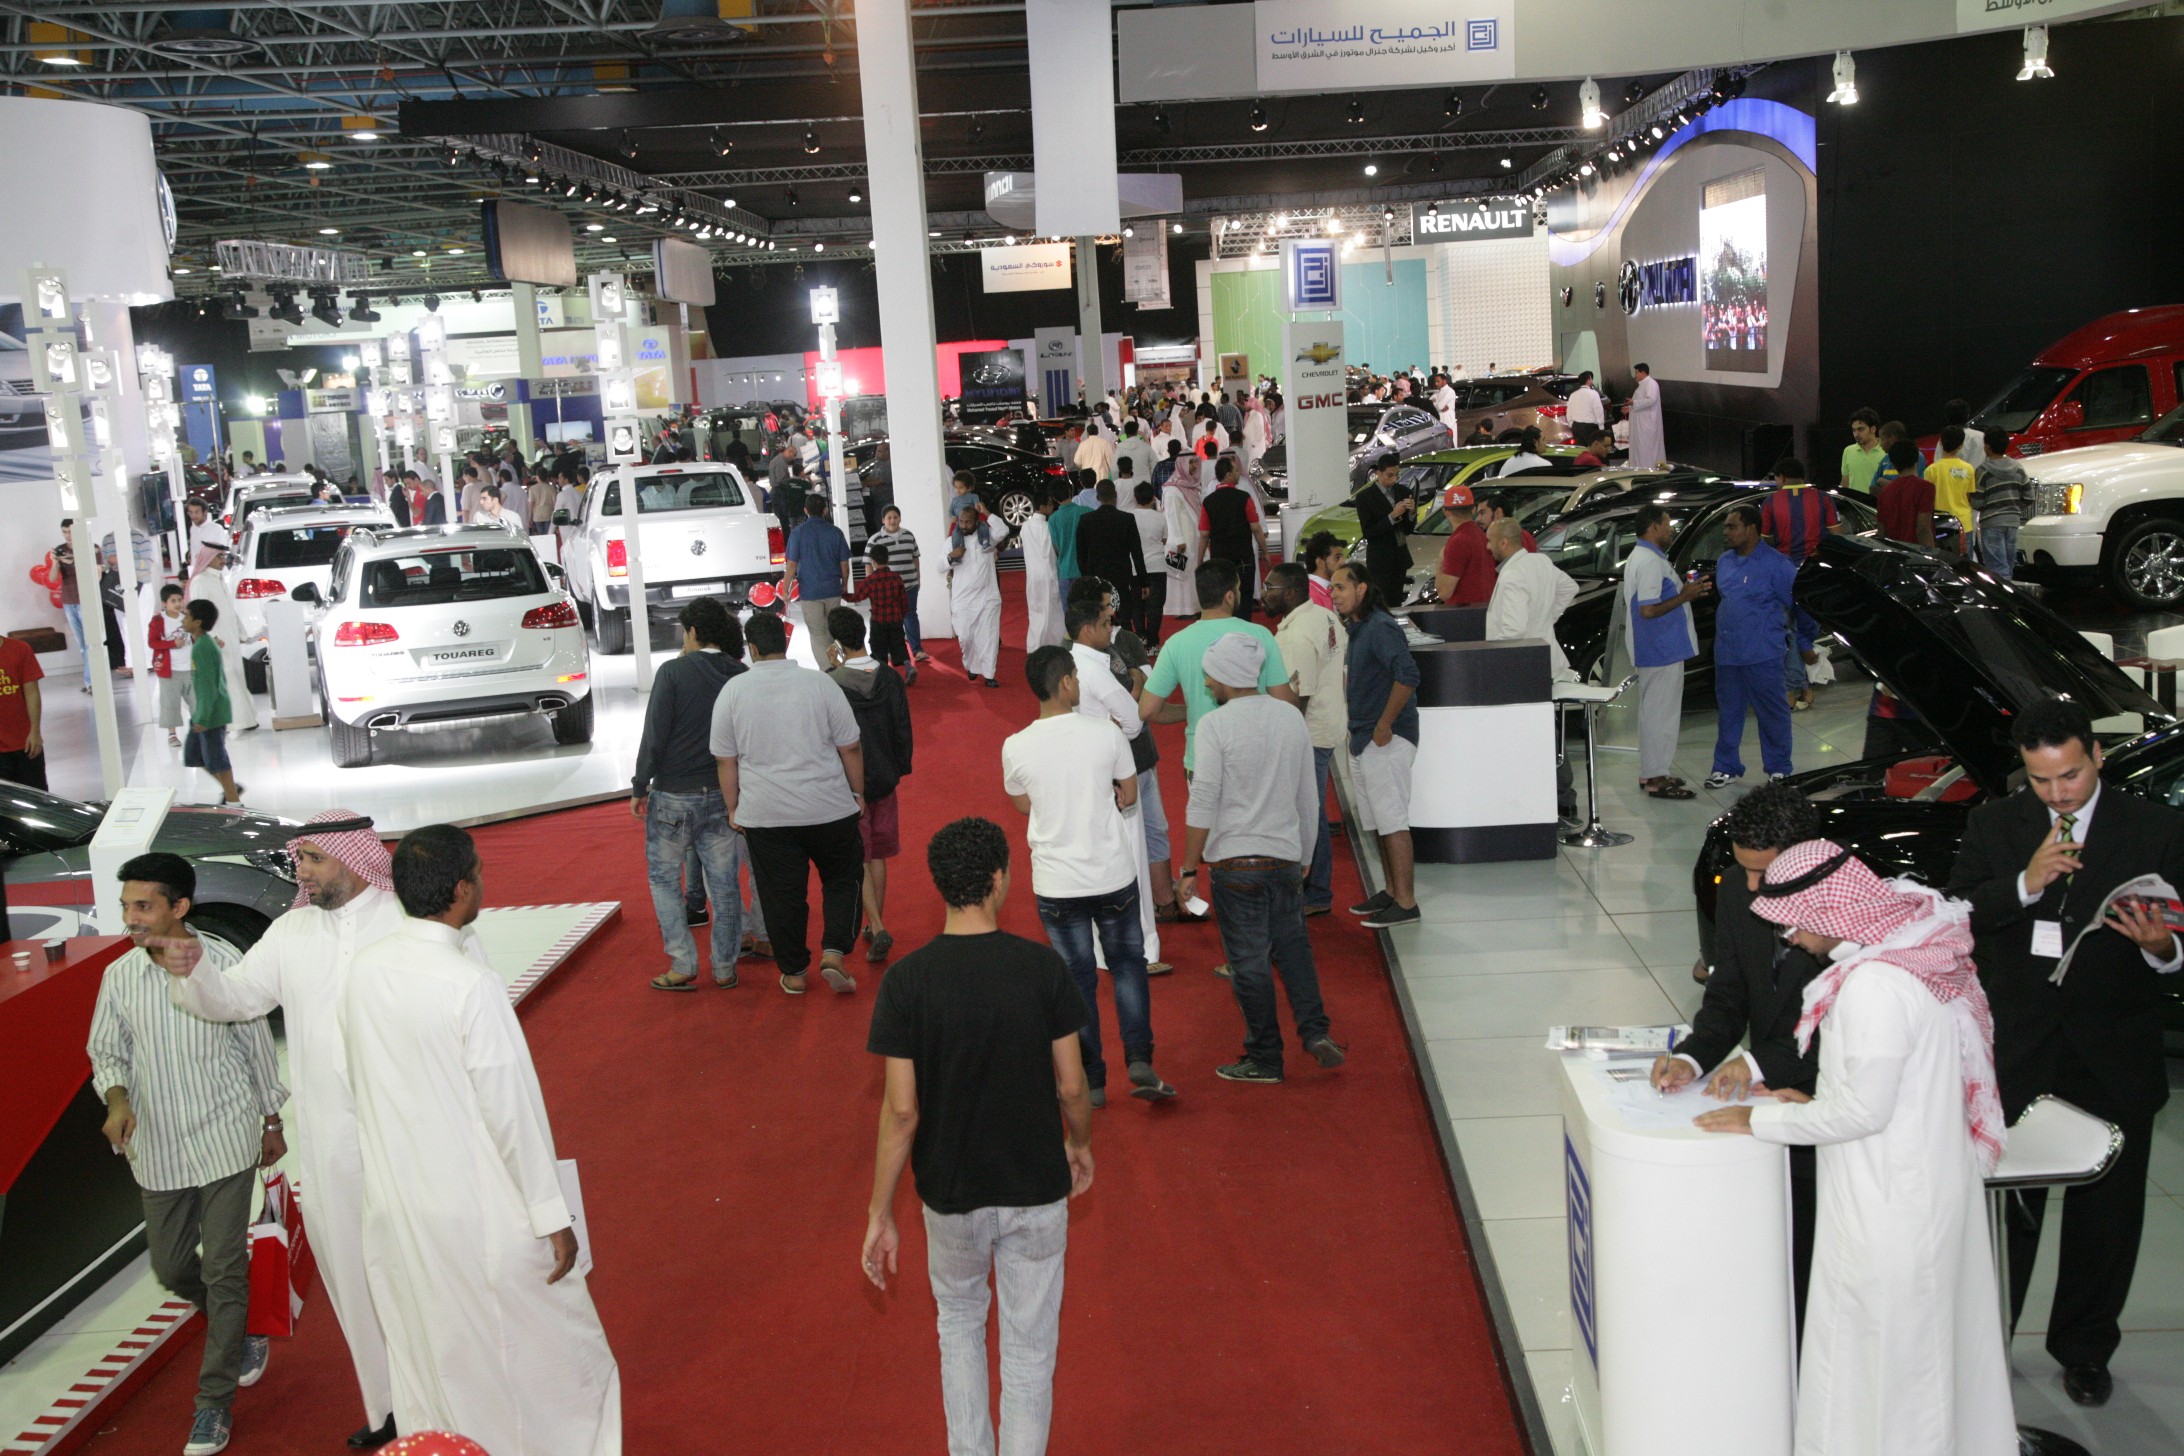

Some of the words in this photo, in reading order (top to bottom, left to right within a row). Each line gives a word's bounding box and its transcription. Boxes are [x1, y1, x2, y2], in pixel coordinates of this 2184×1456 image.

[1271, 25, 1363, 48] للسيارات
[1370, 21, 1455, 45] الجميح
[1365, 47, 1388, 57] جنرال
[1388, 45, 1416, 55] لشركة
[1416, 45, 1438, 54] وكيل
[1440, 42, 1456, 53] أكبر
[1271, 50, 1300, 60] الأوسط
[1300, 49, 1325, 60] الشرق
[1325, 51, 1339, 60] في
[1340, 49, 1365, 58] موتورز
[1419, 209, 1527, 234] RENAULT
[1301, 369, 1339, 379] CHEVROLET
[192, 383, 213, 392] TATA
[1296, 391, 1344, 411] GMC
[433, 648, 495, 661] TOUAREG
